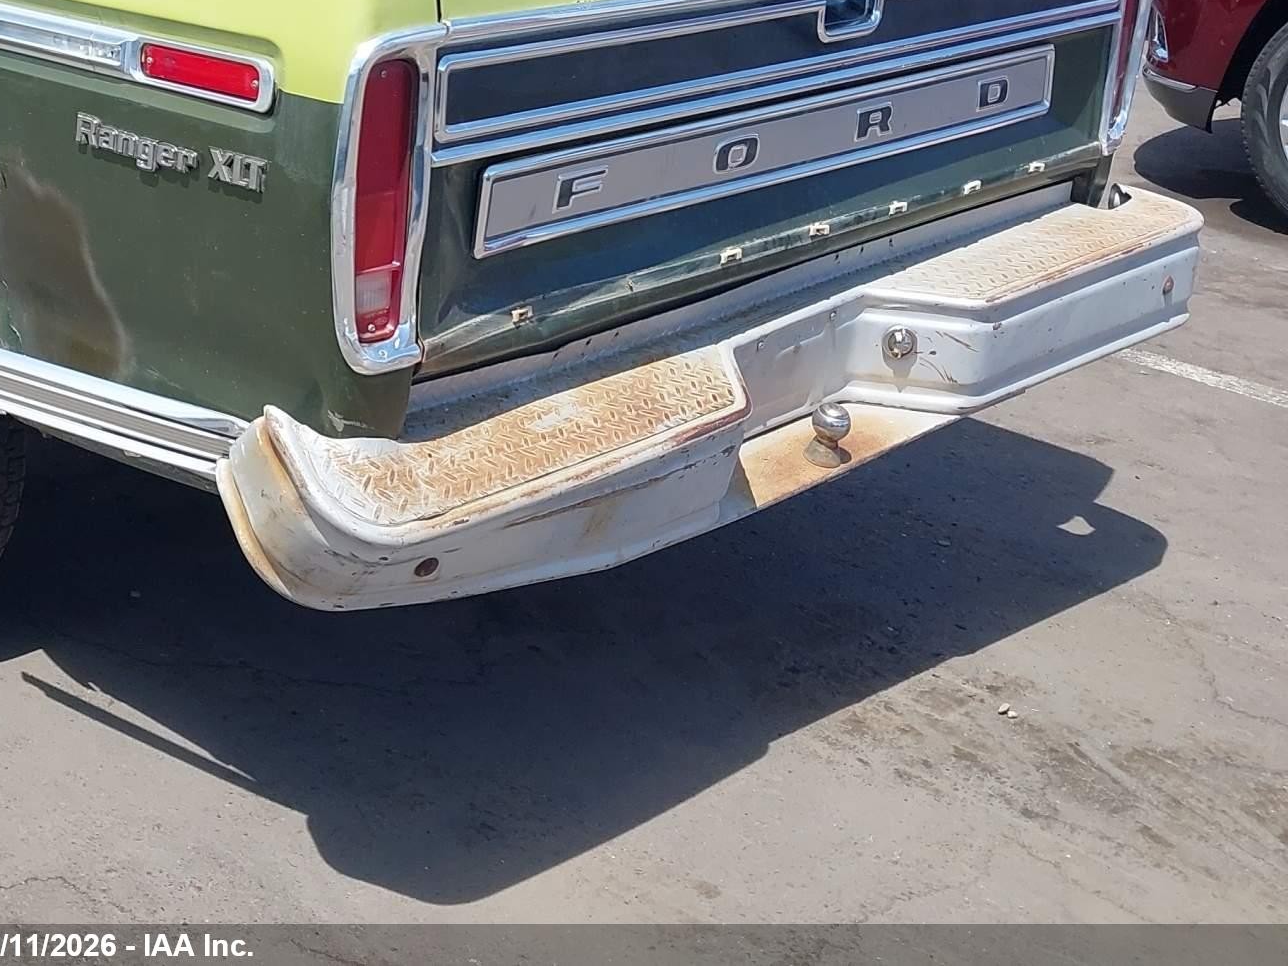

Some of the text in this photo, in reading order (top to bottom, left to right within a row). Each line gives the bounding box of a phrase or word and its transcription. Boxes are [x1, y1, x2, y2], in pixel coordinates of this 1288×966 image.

[75, 111, 270, 193] Ranger XLT
[552, 74, 1010, 215] FORD
